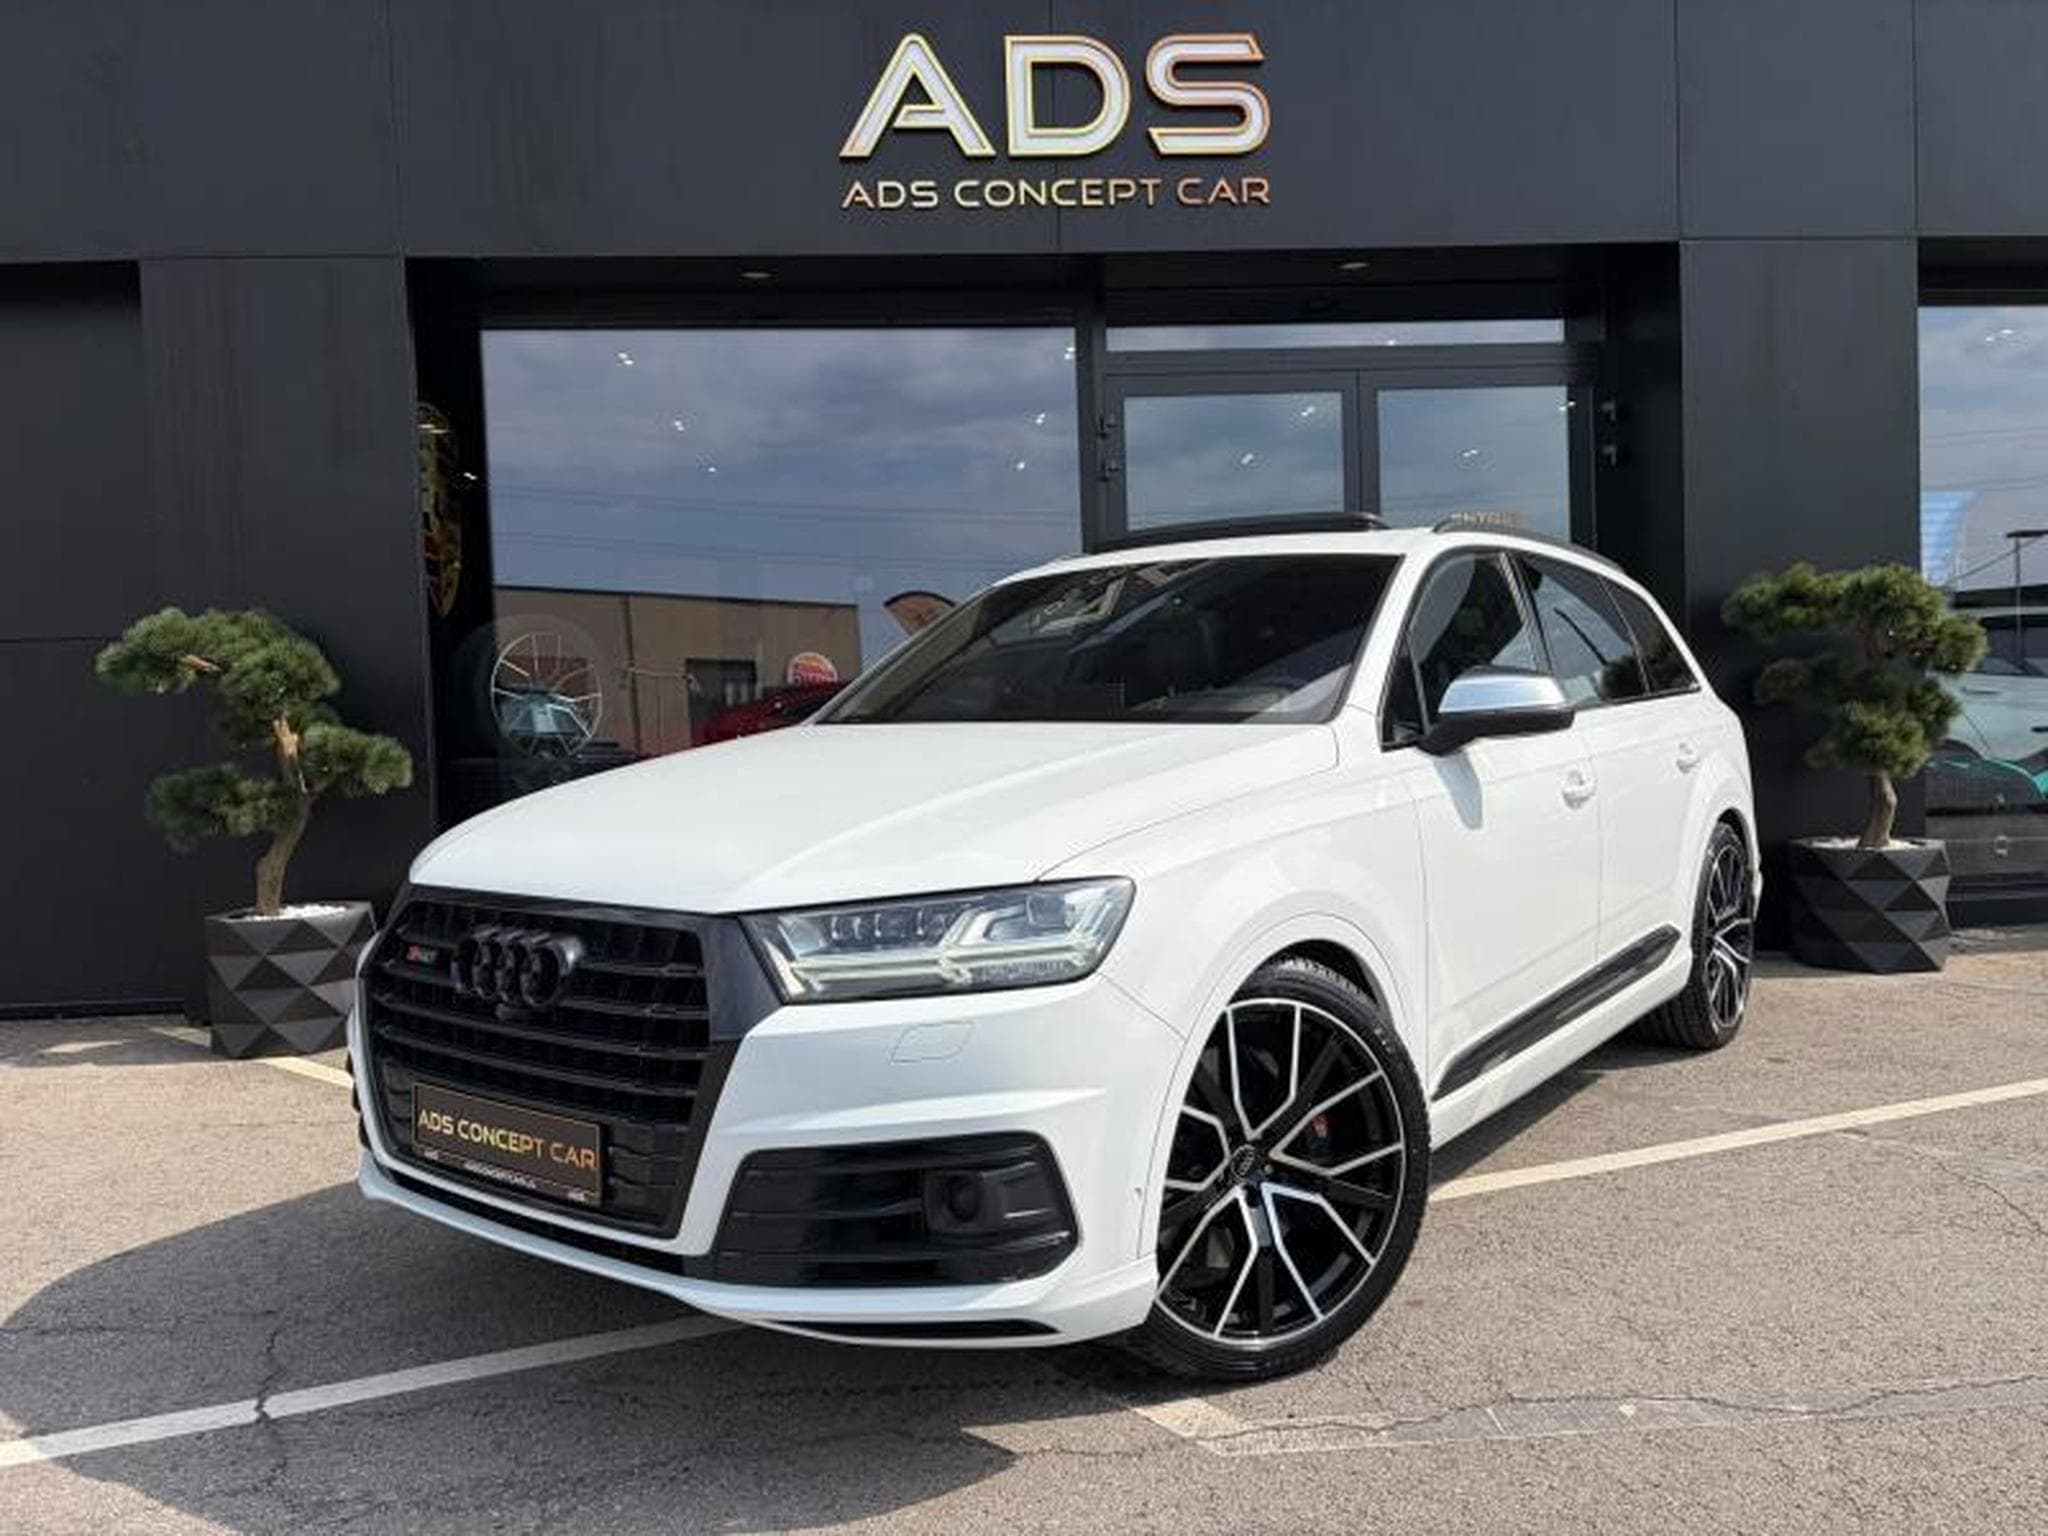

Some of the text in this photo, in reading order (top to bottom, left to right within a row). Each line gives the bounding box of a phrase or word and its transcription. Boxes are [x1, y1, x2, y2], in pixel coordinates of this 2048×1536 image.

[839, 33, 1271, 157] ADS
[842, 178, 1272, 209] ADS CONCEPT CAR
[417, 1108, 597, 1171] ADS CONCEPT CAR
